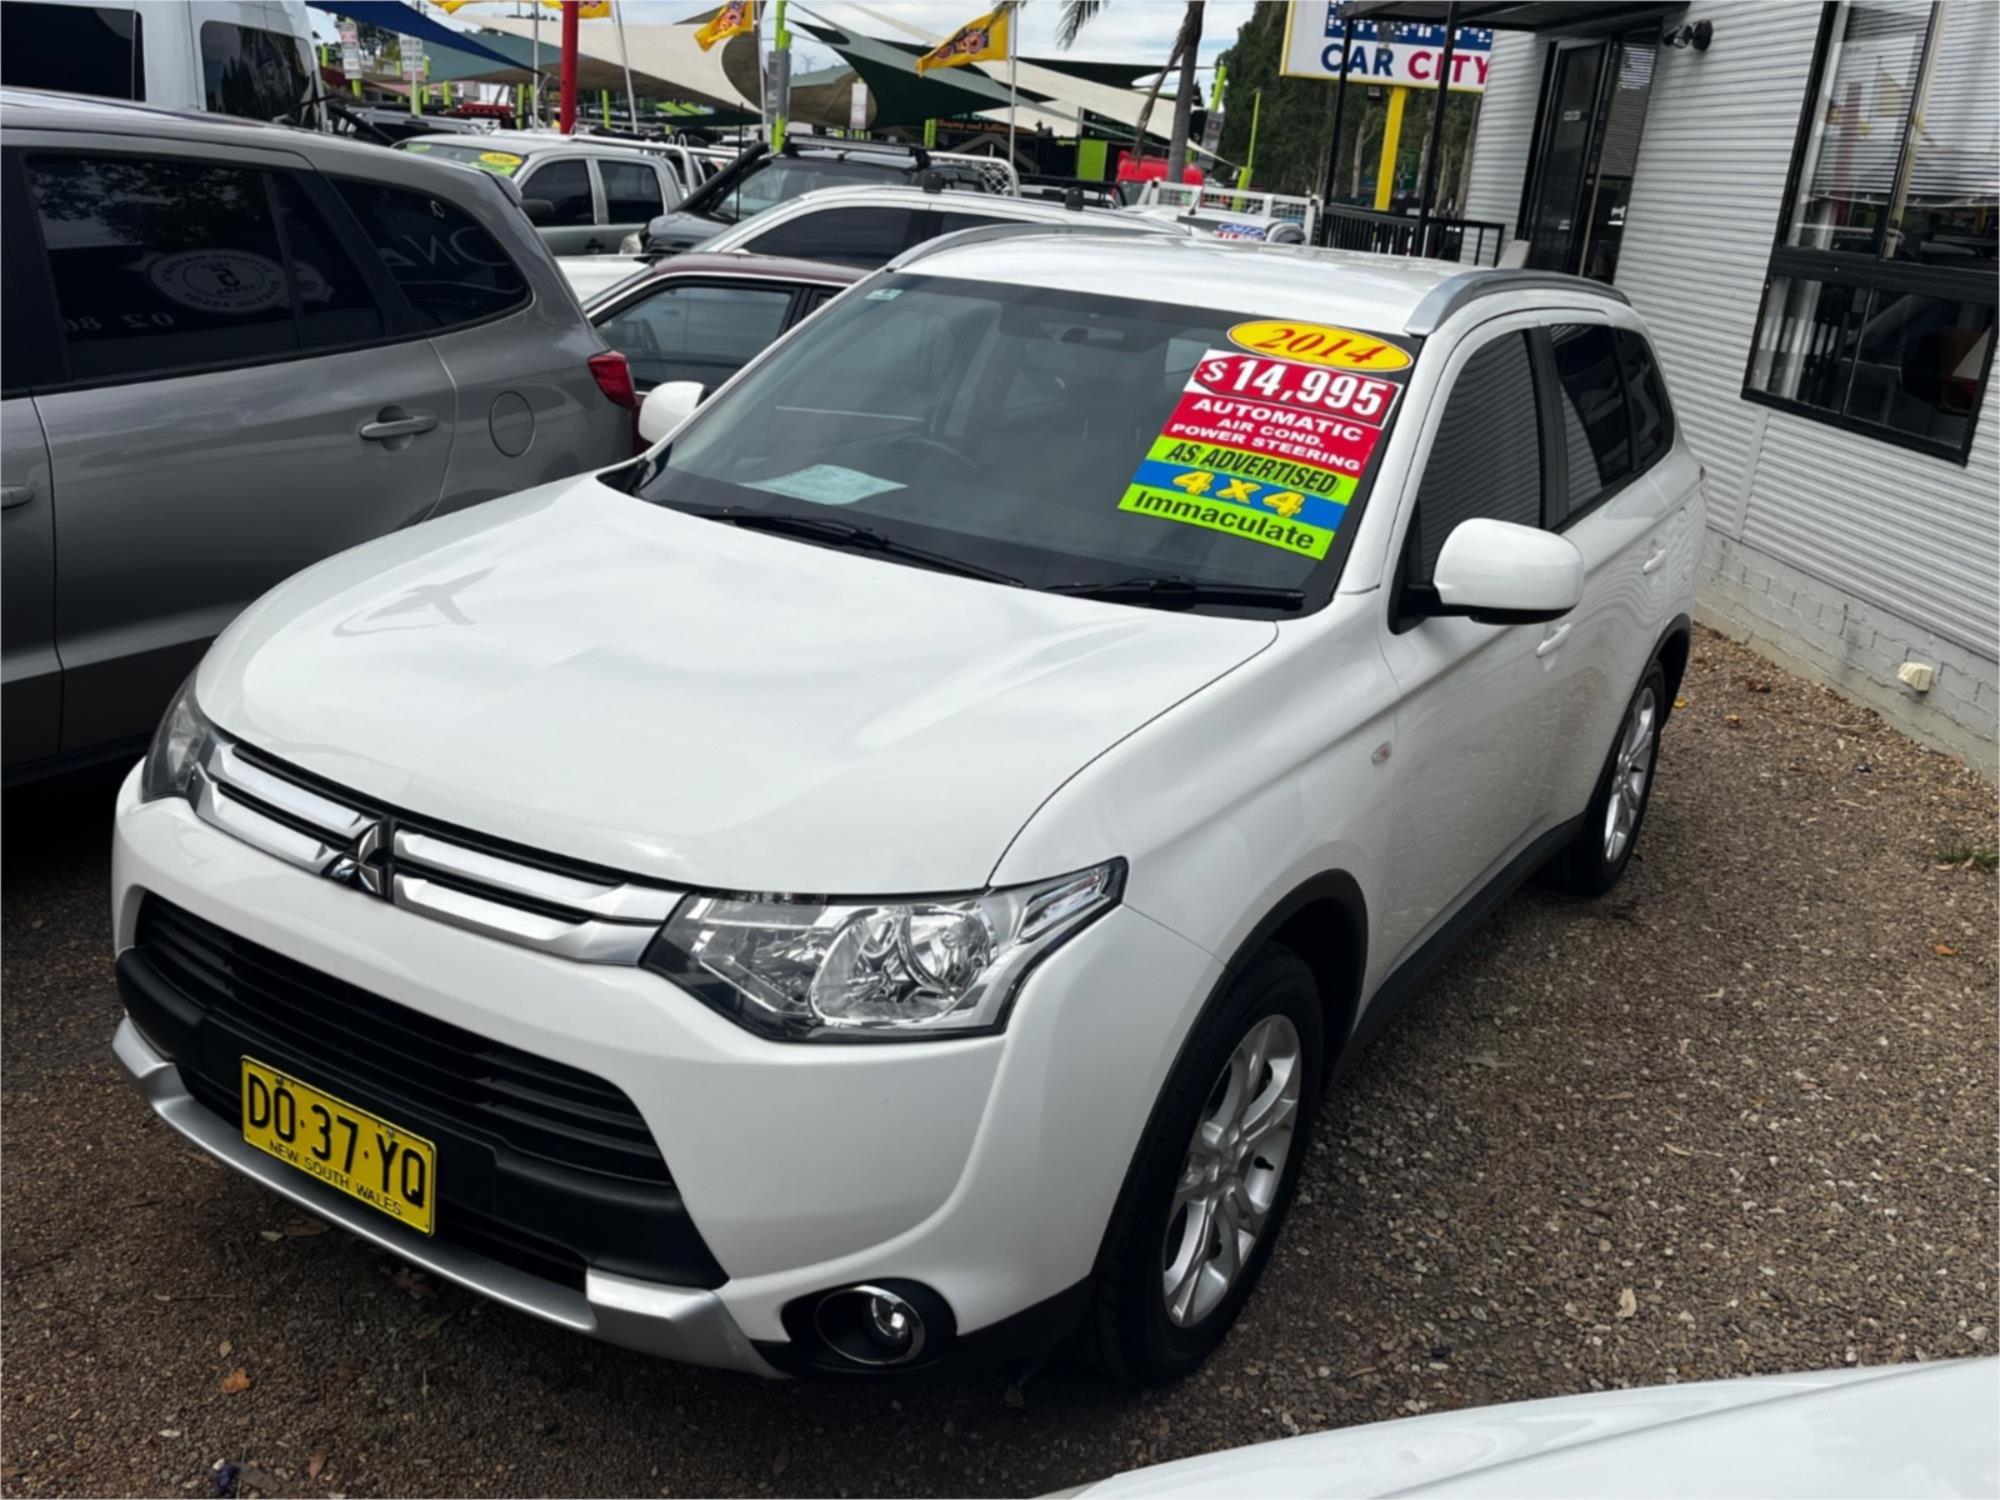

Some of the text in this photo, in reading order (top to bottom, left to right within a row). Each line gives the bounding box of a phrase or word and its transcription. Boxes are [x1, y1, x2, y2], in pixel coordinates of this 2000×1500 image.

[1321, 43, 1489, 84] CAR CITY
[1253, 328, 1387, 363] 2014
[1191, 398, 1363, 441] AUTOMATIC
[1217, 418, 1325, 448] AIR COND.
[1165, 441, 1339, 496] AS ADVERTISED
[1171, 423, 1360, 471] POWER STEERING
[1134, 491, 1315, 550] Immaculate
[269, 1139, 402, 1216] NEW SOUTH WALES
